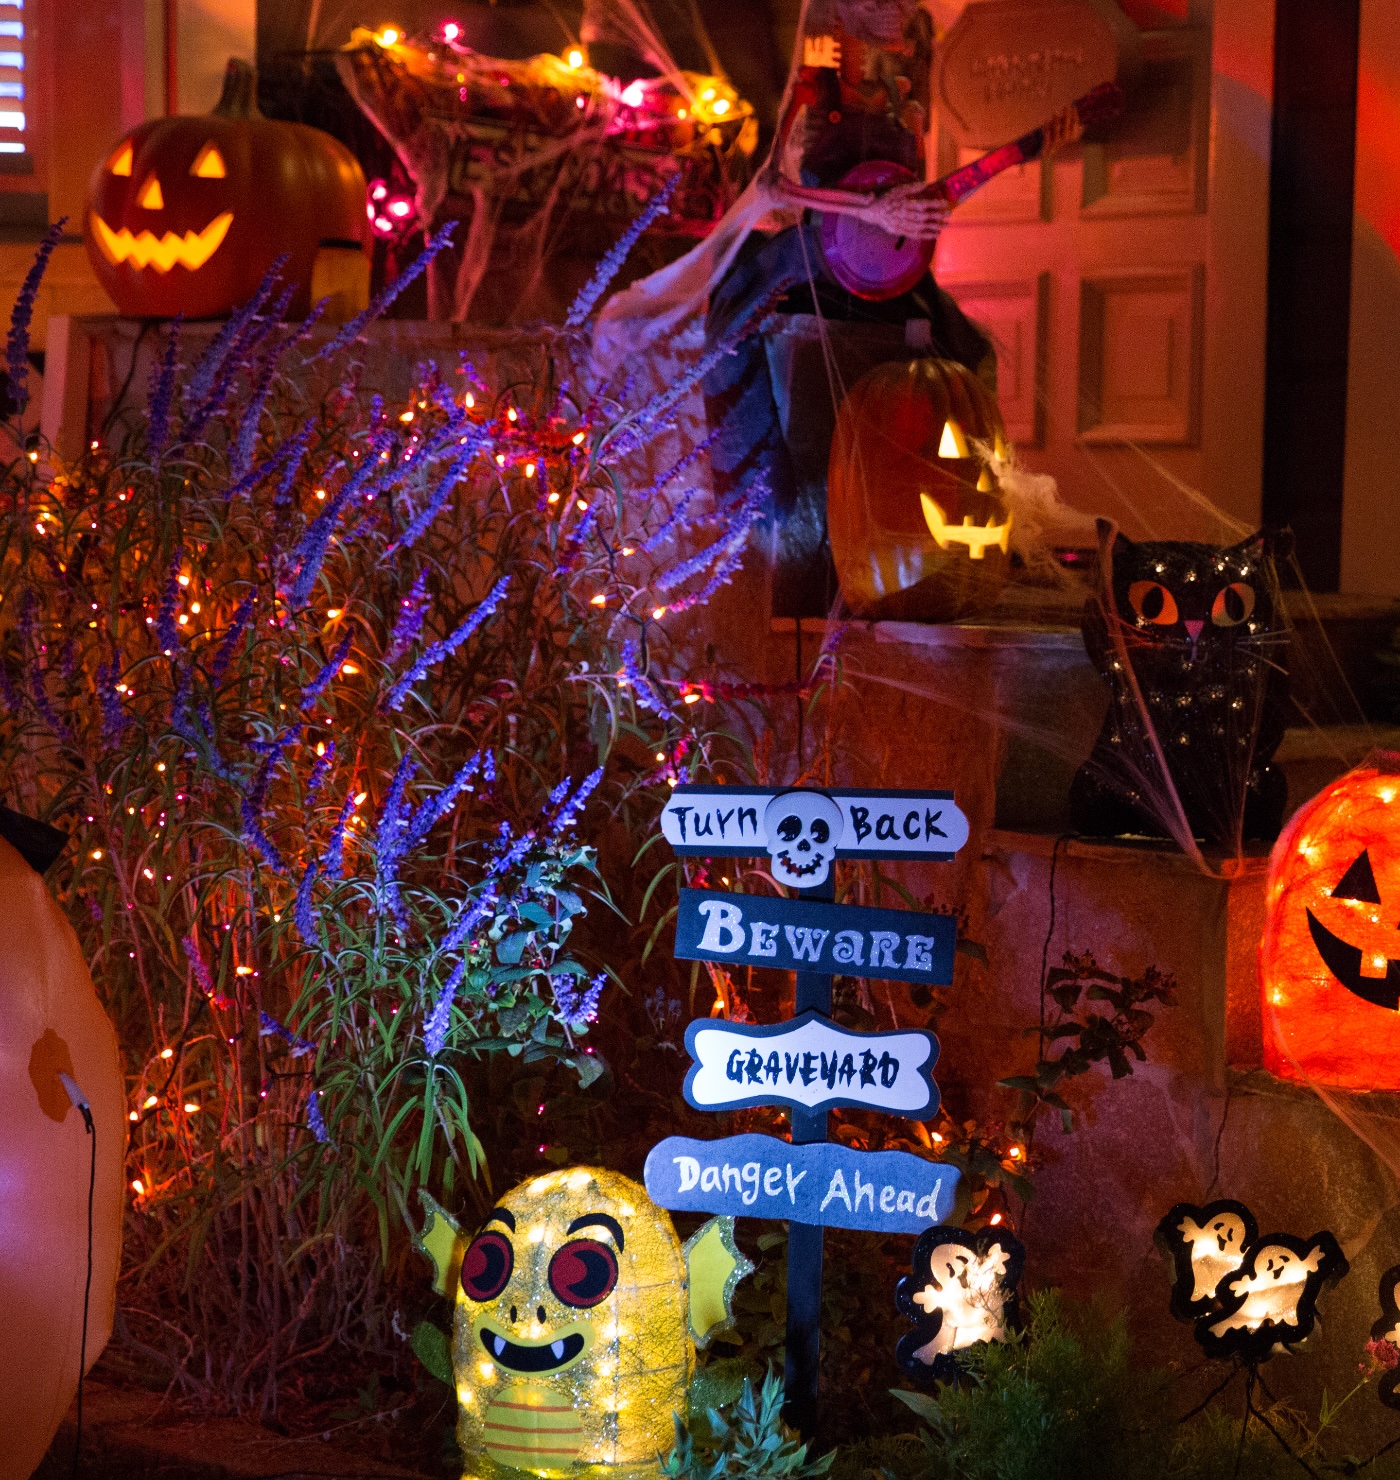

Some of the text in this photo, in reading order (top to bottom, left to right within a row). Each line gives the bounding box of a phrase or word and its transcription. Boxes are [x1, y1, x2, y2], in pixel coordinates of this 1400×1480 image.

[668, 804, 950, 845] Turn Back
[725, 1047, 901, 1090] GRAVEYARD
[672, 1155, 943, 1222] Danger Ahead
